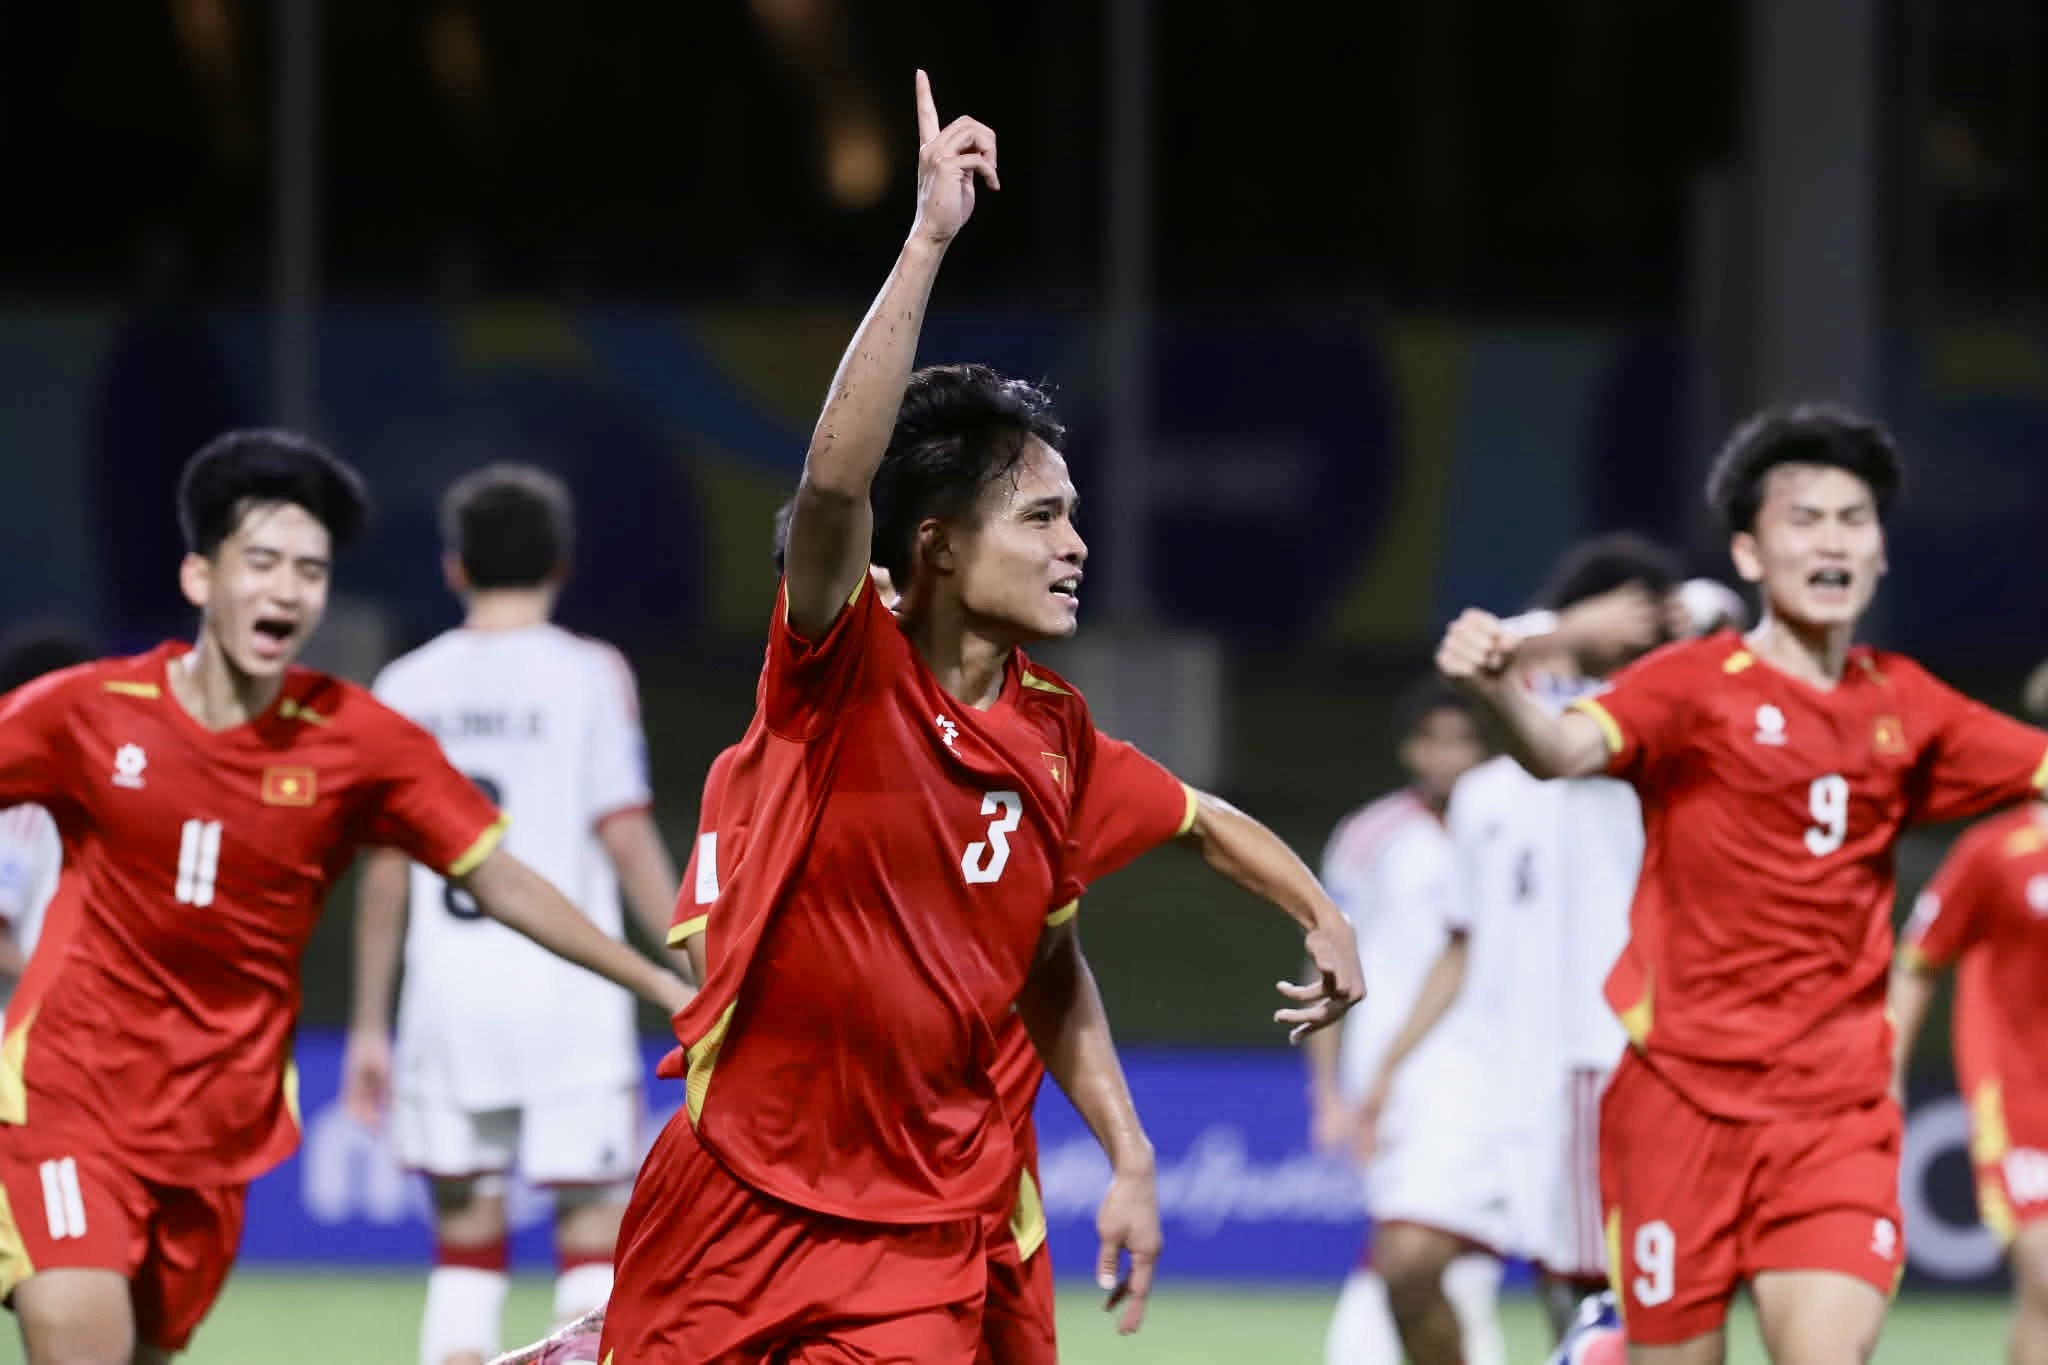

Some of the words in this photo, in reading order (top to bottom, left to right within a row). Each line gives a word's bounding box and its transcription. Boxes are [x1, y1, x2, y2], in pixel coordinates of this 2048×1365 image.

[961, 791, 1023, 884] 3
[1804, 774, 1849, 858] 9
[175, 819, 223, 908] 11
[38, 1156, 88, 1240] 11
[1633, 1219, 1675, 1307] 9
